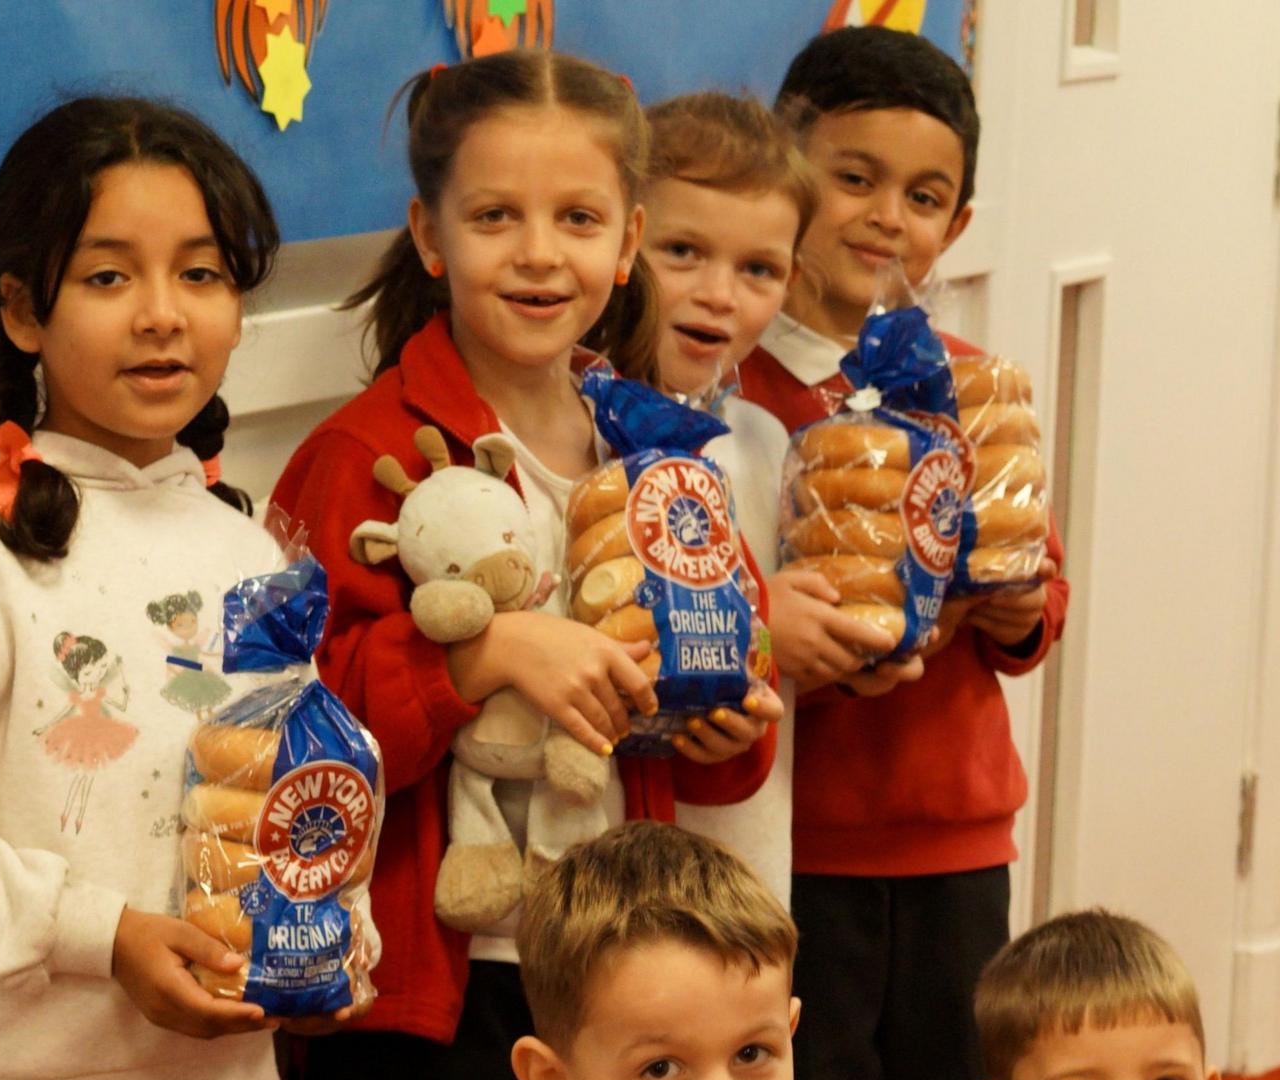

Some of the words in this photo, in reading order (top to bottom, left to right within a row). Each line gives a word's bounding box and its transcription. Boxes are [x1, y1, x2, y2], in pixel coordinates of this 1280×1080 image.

[691, 591, 717, 610] THE
[681, 645, 739, 671] BAGELS
[268, 772, 323, 829] NEW
[251, 891, 259, 908] 5
[295, 904, 315, 924] TH
